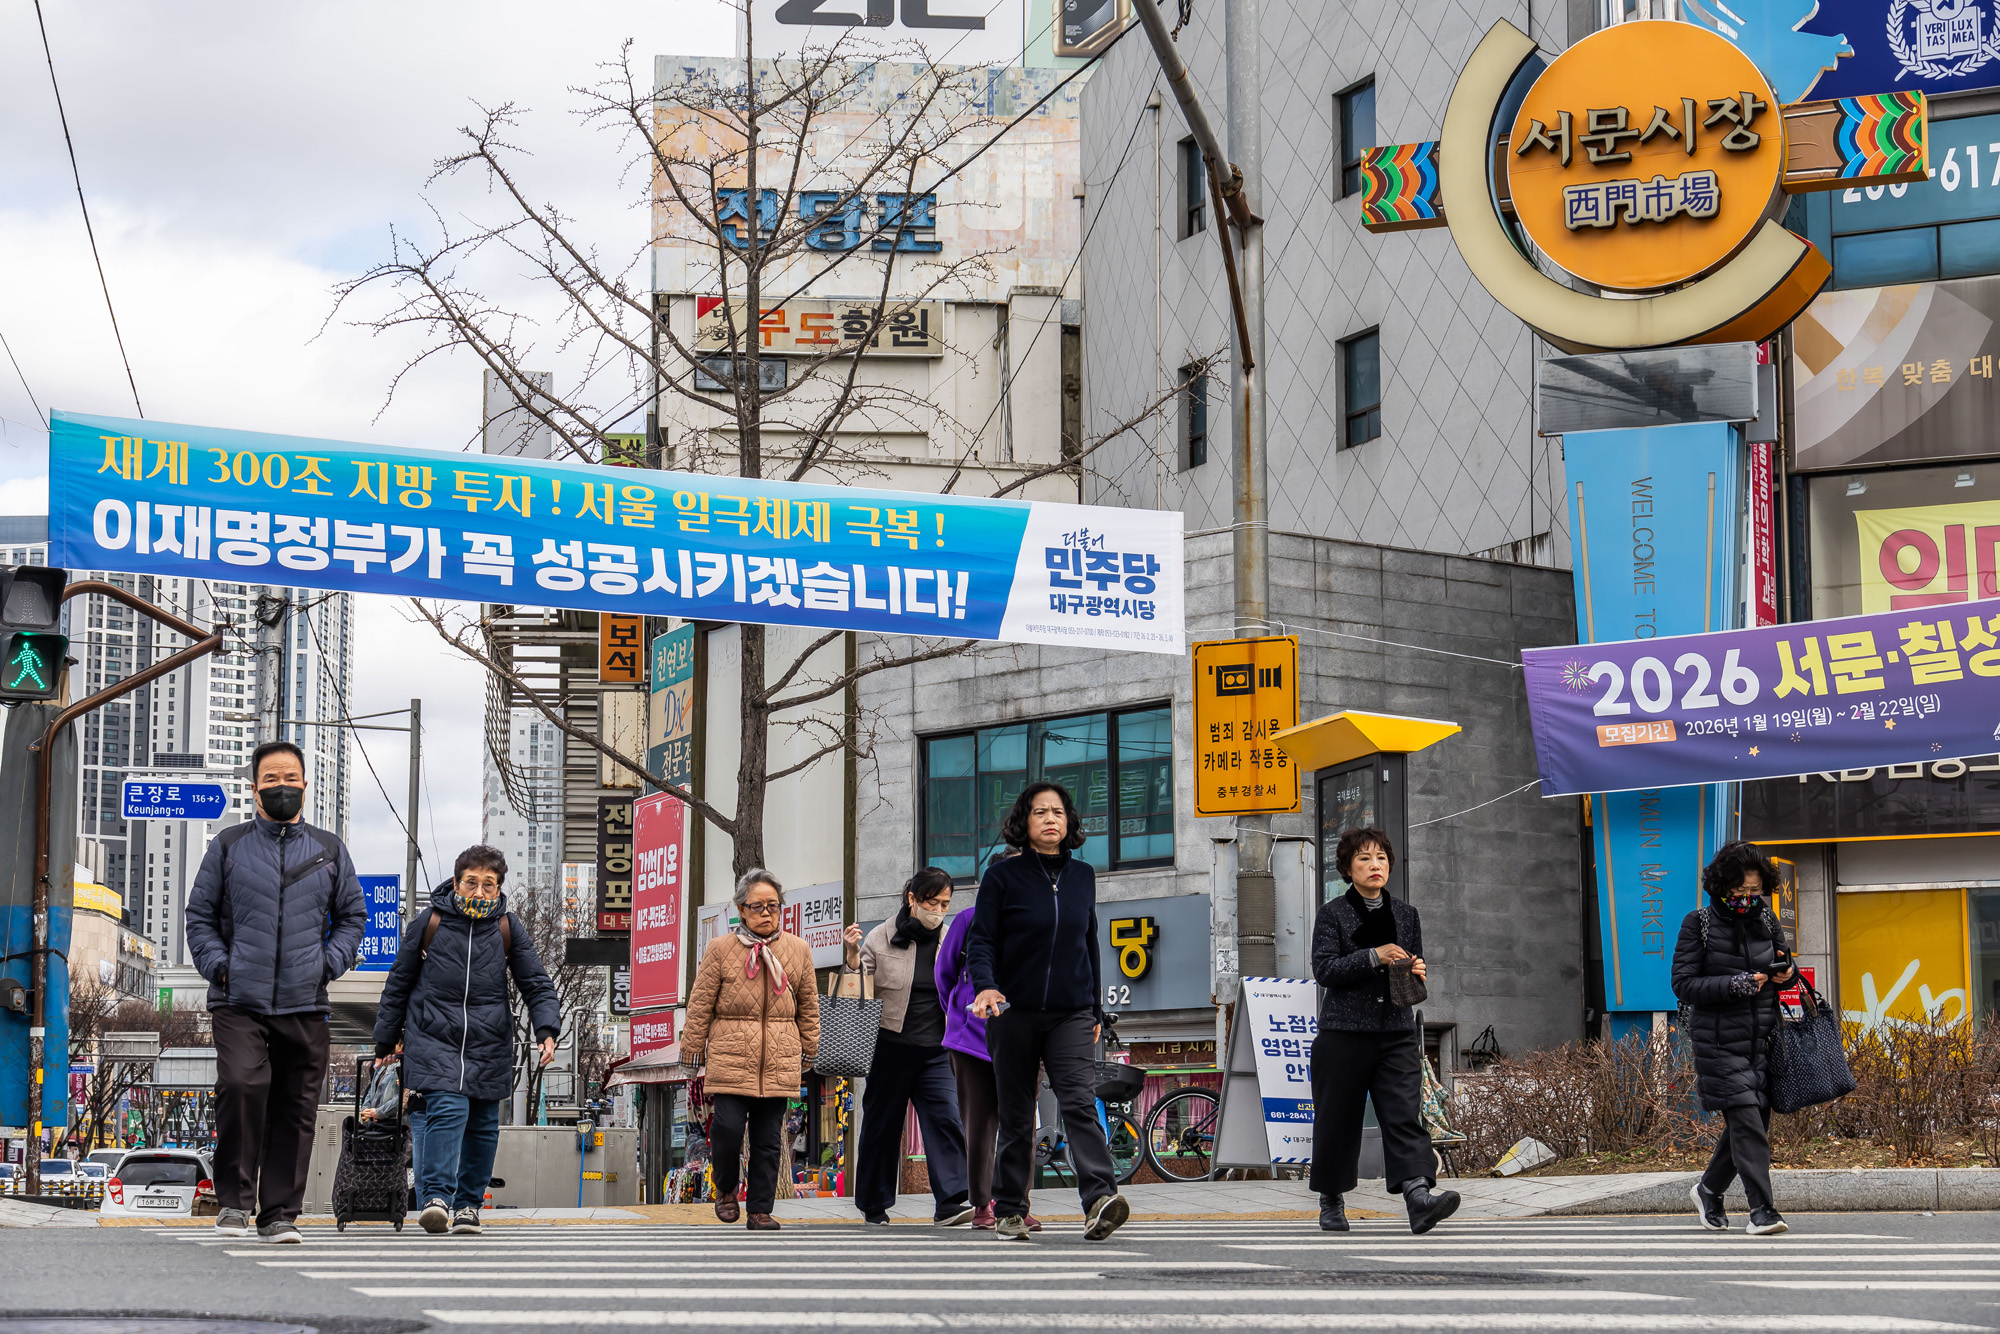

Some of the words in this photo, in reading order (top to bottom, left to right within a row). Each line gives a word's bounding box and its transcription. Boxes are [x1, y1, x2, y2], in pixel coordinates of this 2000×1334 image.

[1924, 22, 1946, 35] VERI
[1951, 18, 1973, 32] LUX
[1926, 34, 1946, 47] TAS
[1951, 32, 1975, 44] MEA
[1516, 91, 1768, 168] 서문시장
[1566, 172, 1718, 226] 西門市場
[716, 187, 943, 252] 전당포
[758, 308, 929, 348] 무도학원
[1836, 364, 1886, 391] 한복
[1902, 358, 1953, 387] 맞춤
[97, 435, 189, 484] 재계
[207, 445, 334, 494] 300조
[348, 461, 438, 509] 지방
[452, 470, 536, 518] 투자
[575, 481, 658, 530] 서울
[672, 489, 831, 544] 일극체제
[846, 506, 922, 551] 극복
[1061, 527, 1105, 551] 더불어
[1630, 476, 1656, 596] WELCOME
[93, 497, 446, 580] 이재명정부가
[462, 530, 515, 587] 꼭
[532, 535, 970, 619] 성공시키겠습니다!
[1045, 547, 1161, 595] 민주당
[1049, 594, 1156, 621] 대구광역시당
[1634, 608, 1657, 640] TO
[605, 613, 639, 678] 보석
[1587, 649, 1761, 716] 2026
[1685, 717, 1739, 736] 2026년
[1744, 714, 1768, 732] 1월
[1772, 706, 1833, 728] 19일(월)
[1850, 702, 1876, 720] 2월
[1879, 694, 1942, 717] 22일(일)
[1210, 721, 1234, 742] 범죄
[1242, 719, 1280, 741] 감시용
[1605, 722, 1670, 743] 모집기간
[1204, 750, 1241, 772] 카메라
[1249, 748, 1288, 770] 작동중
[128, 785, 182, 803] 큰장로
[1217, 784, 1277, 799] 중부경찰서
[128, 804, 185, 817] Keunjang-ro
[604, 803, 633, 910] 전당포
[374, 886, 396, 903] 09:00
[374, 911, 395, 929] 19:30
[604, 914, 631, 928] 대부
[804, 895, 843, 924] 주문/제작
[1641, 863, 1665, 960] MARKET
[381, 937, 396, 955] 제외
[805, 928, 842, 949] 010-5526-2628
[1110, 916, 1160, 980] 당
[1155, 1043, 1182, 1055] 고급
